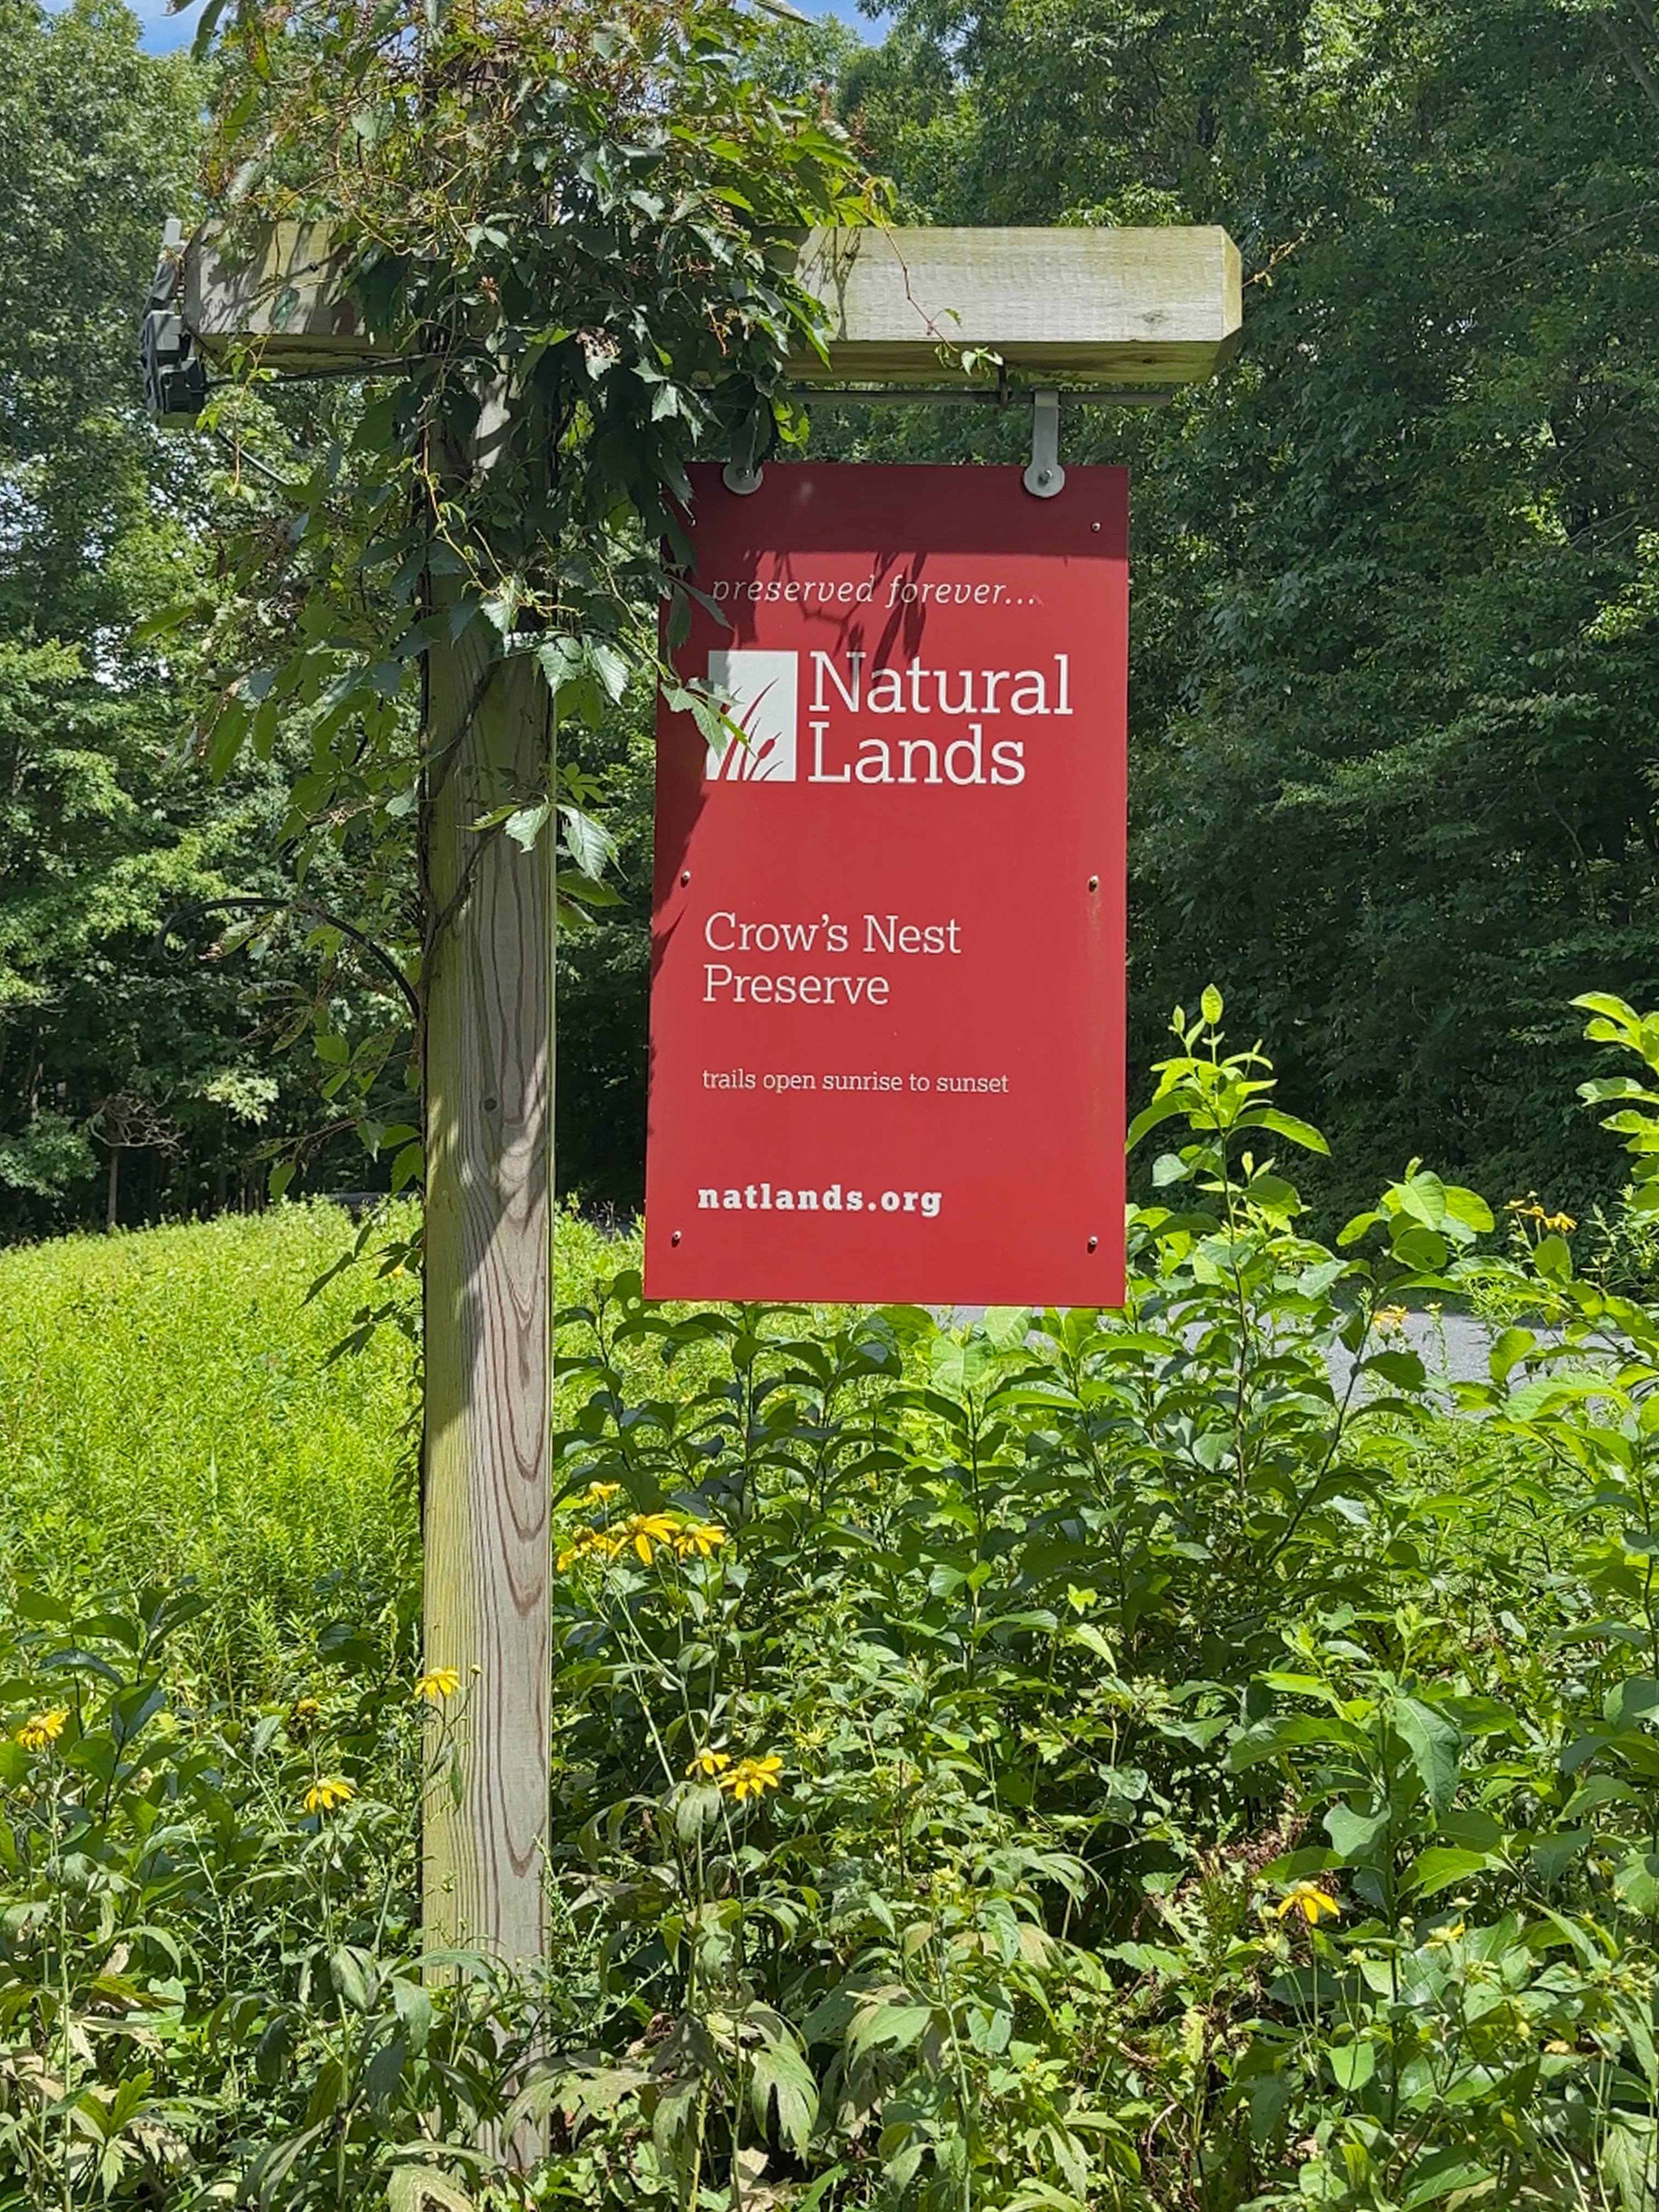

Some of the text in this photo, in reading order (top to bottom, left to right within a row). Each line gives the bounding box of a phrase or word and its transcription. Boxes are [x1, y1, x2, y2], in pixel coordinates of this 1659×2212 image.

[712, 574, 1035, 608] preserved forever...
[809, 651, 1074, 715] Natural
[808, 721, 1026, 786] Lands
[704, 912, 961, 953] Crow’s Nest
[703, 964, 890, 1005] Preserve
[702, 1069, 1008, 1093] trails open sunrise to sunset
[698, 1183, 942, 1218] natlands.org
